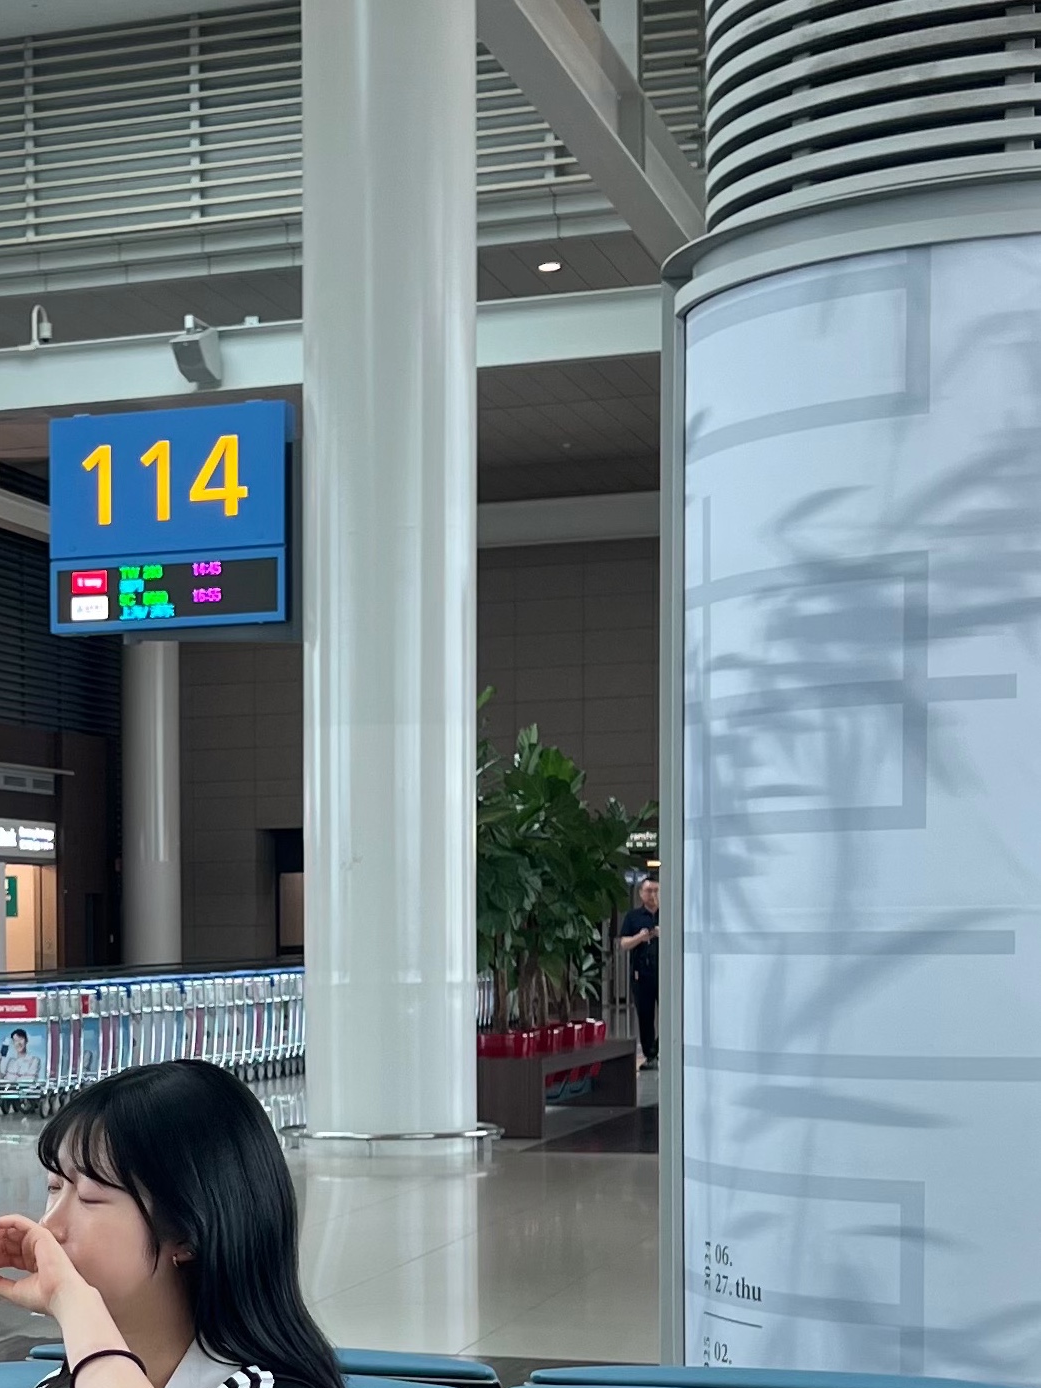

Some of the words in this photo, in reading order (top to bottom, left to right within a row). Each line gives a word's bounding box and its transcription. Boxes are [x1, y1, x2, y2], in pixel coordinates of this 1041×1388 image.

[81, 433, 249, 526] 114
[715, 1244, 732, 1266] 06.
[715, 1273, 733, 1297] 27.
[735, 1276, 763, 1302] thu
[714, 1341, 733, 1366] 02.
